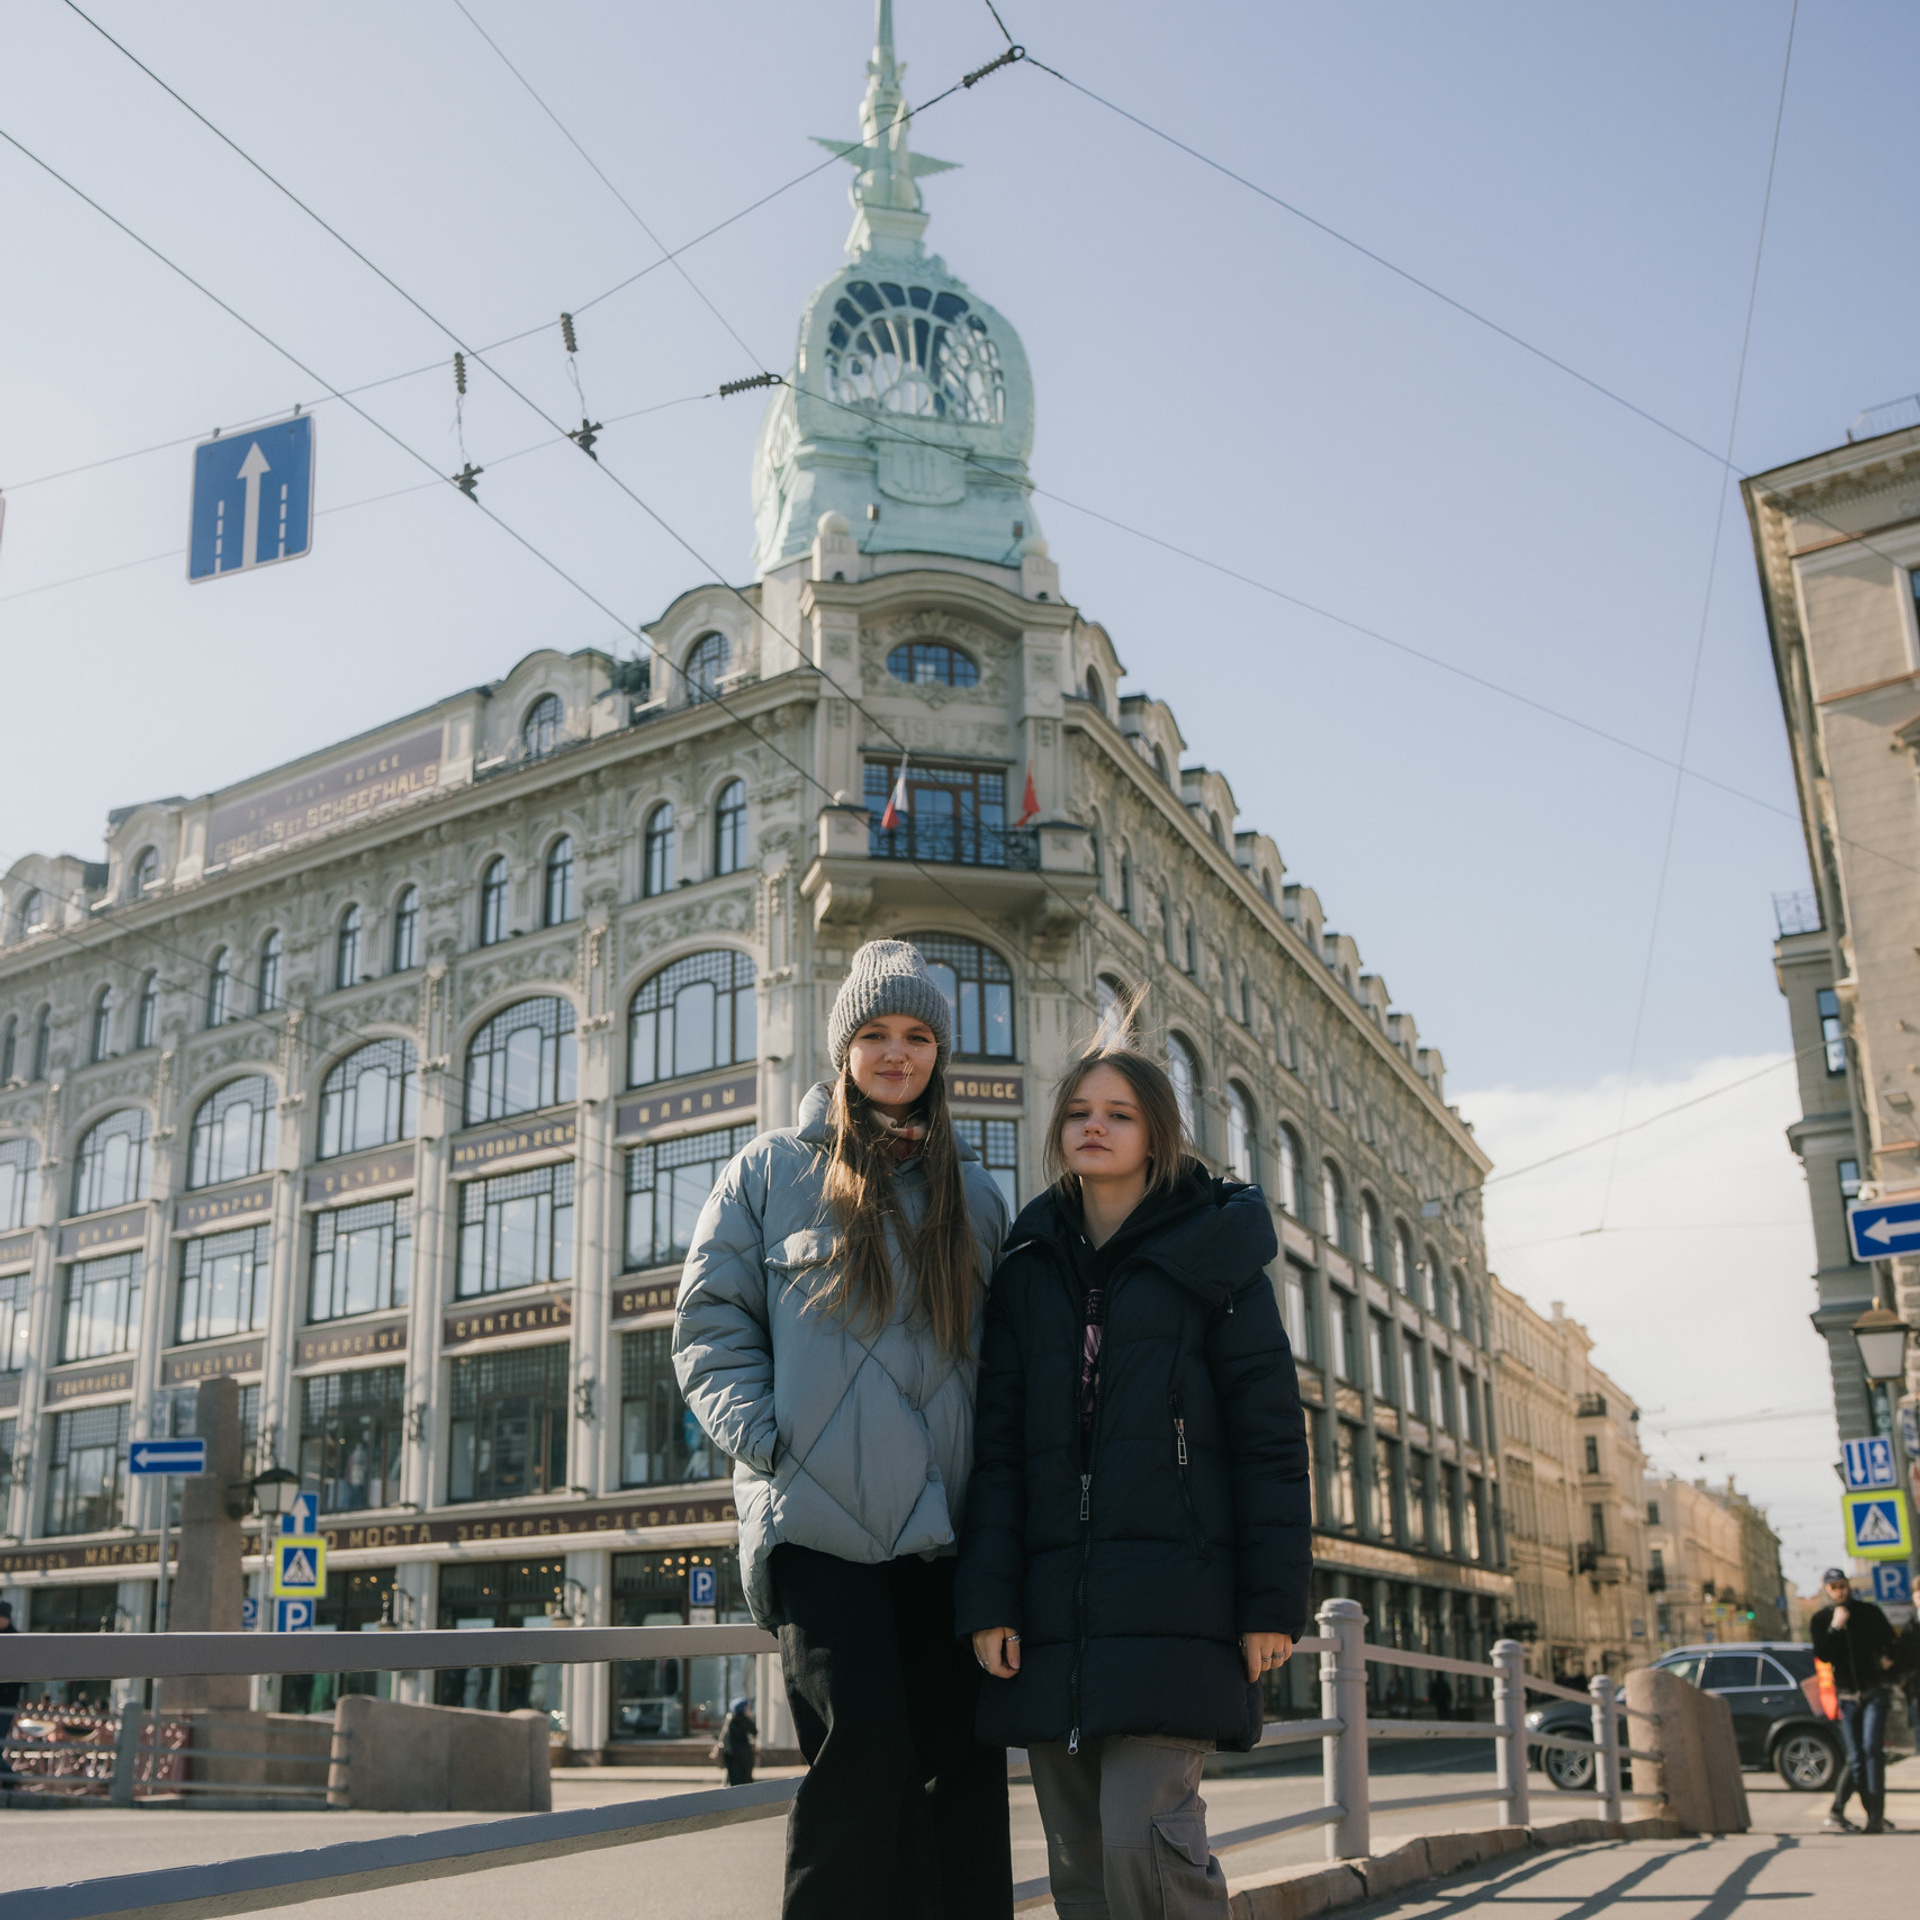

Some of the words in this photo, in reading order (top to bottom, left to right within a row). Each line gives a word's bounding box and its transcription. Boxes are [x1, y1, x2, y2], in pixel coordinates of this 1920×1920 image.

[305, 764, 438, 829] SCHEEFHALS
[953, 1080, 1017, 1100] ROUGE
[304, 1331, 399, 1359] CHAPEAUX
[174, 1352, 253, 1379] LINGERIE
[349, 1523, 432, 1549] МОСТА
[697, 1572, 712, 1600] P
[1880, 1568, 1901, 1598] P
[286, 1602, 308, 1632] P
